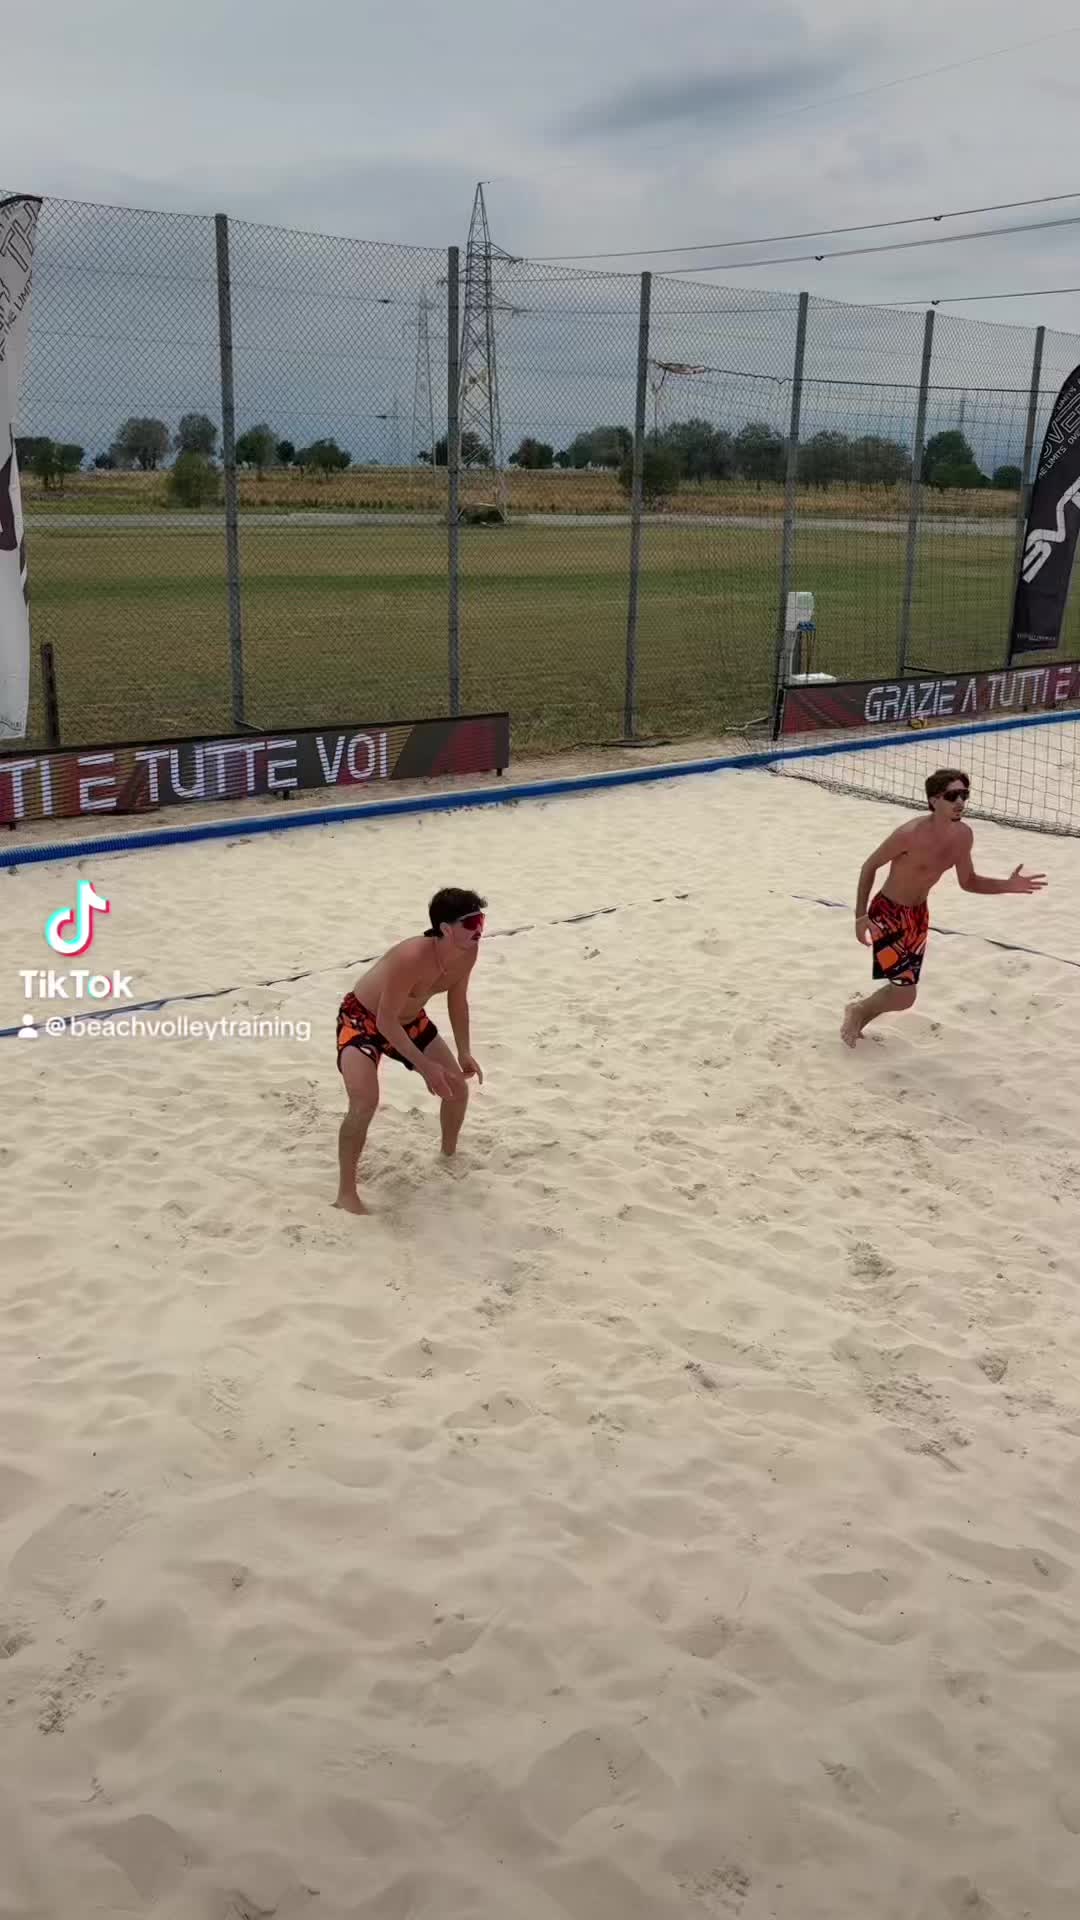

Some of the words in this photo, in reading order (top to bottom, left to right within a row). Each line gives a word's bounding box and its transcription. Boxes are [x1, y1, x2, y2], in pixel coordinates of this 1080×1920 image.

[864, 680, 957, 721] GRAZIE
[988, 668, 1050, 709] TUTTI
[1055, 667, 1072, 700] E
[78, 753, 117, 810] E
[135, 740, 298, 802] TUTTE
[315, 732, 387, 784] VOI
